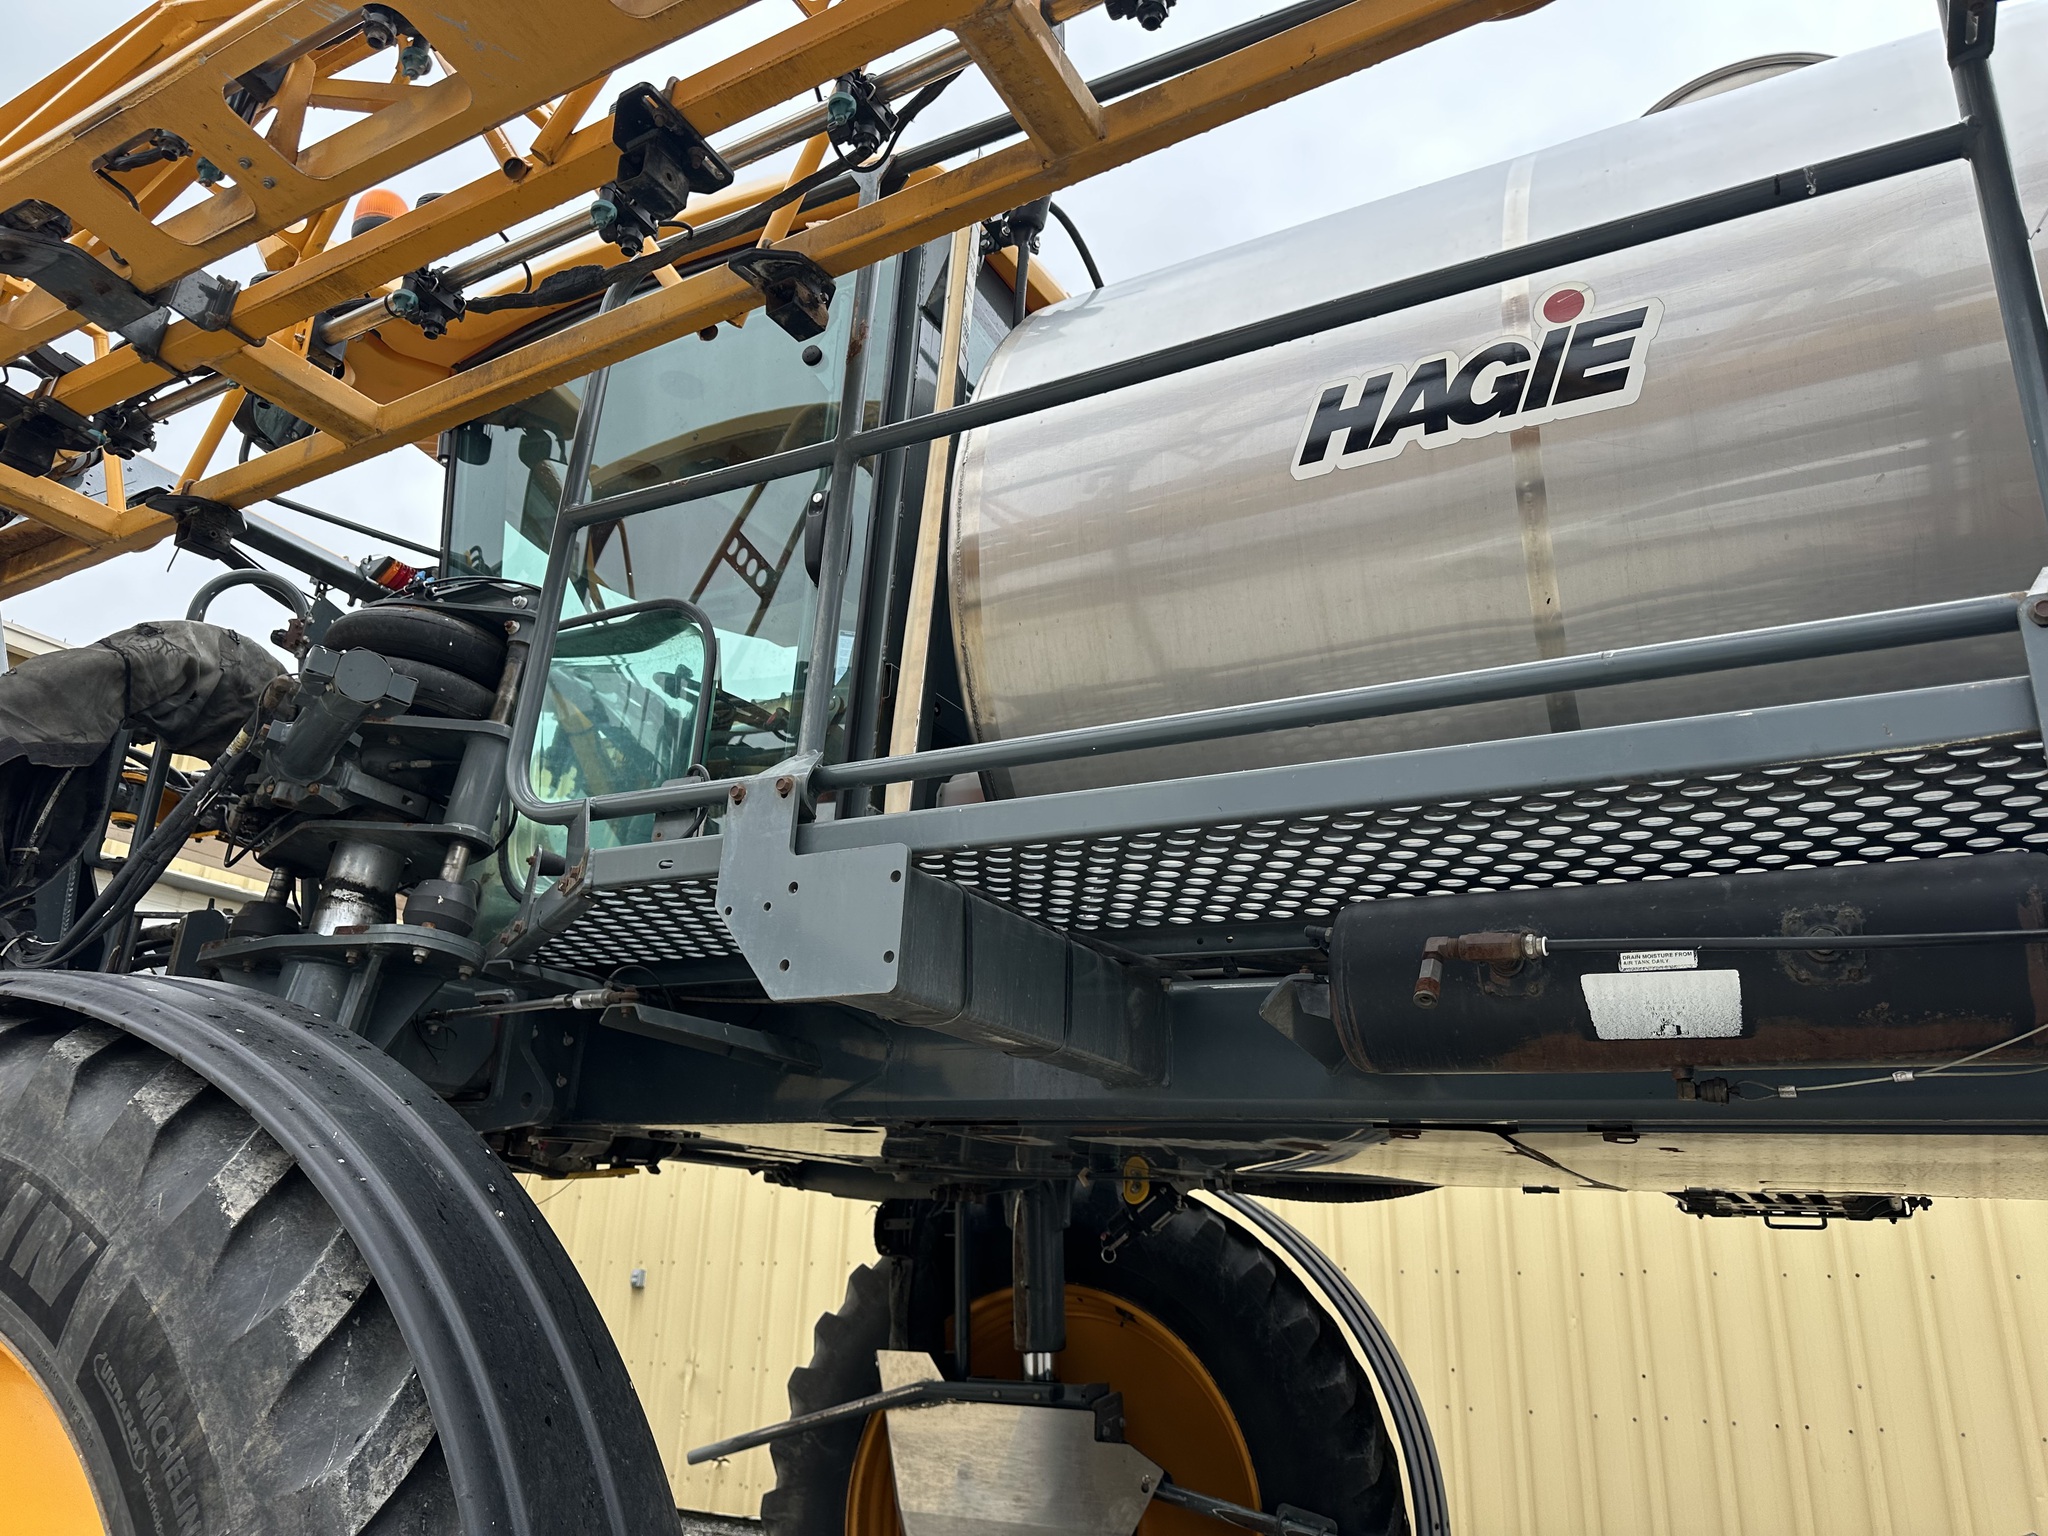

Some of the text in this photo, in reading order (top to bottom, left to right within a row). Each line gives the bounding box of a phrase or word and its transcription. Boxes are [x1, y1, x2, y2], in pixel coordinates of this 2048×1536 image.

[100, 1359, 148, 1460] ULTRAFLEX
[135, 1372, 202, 1536] MICHELIN
[142, 1471, 165, 1536] Technolo
